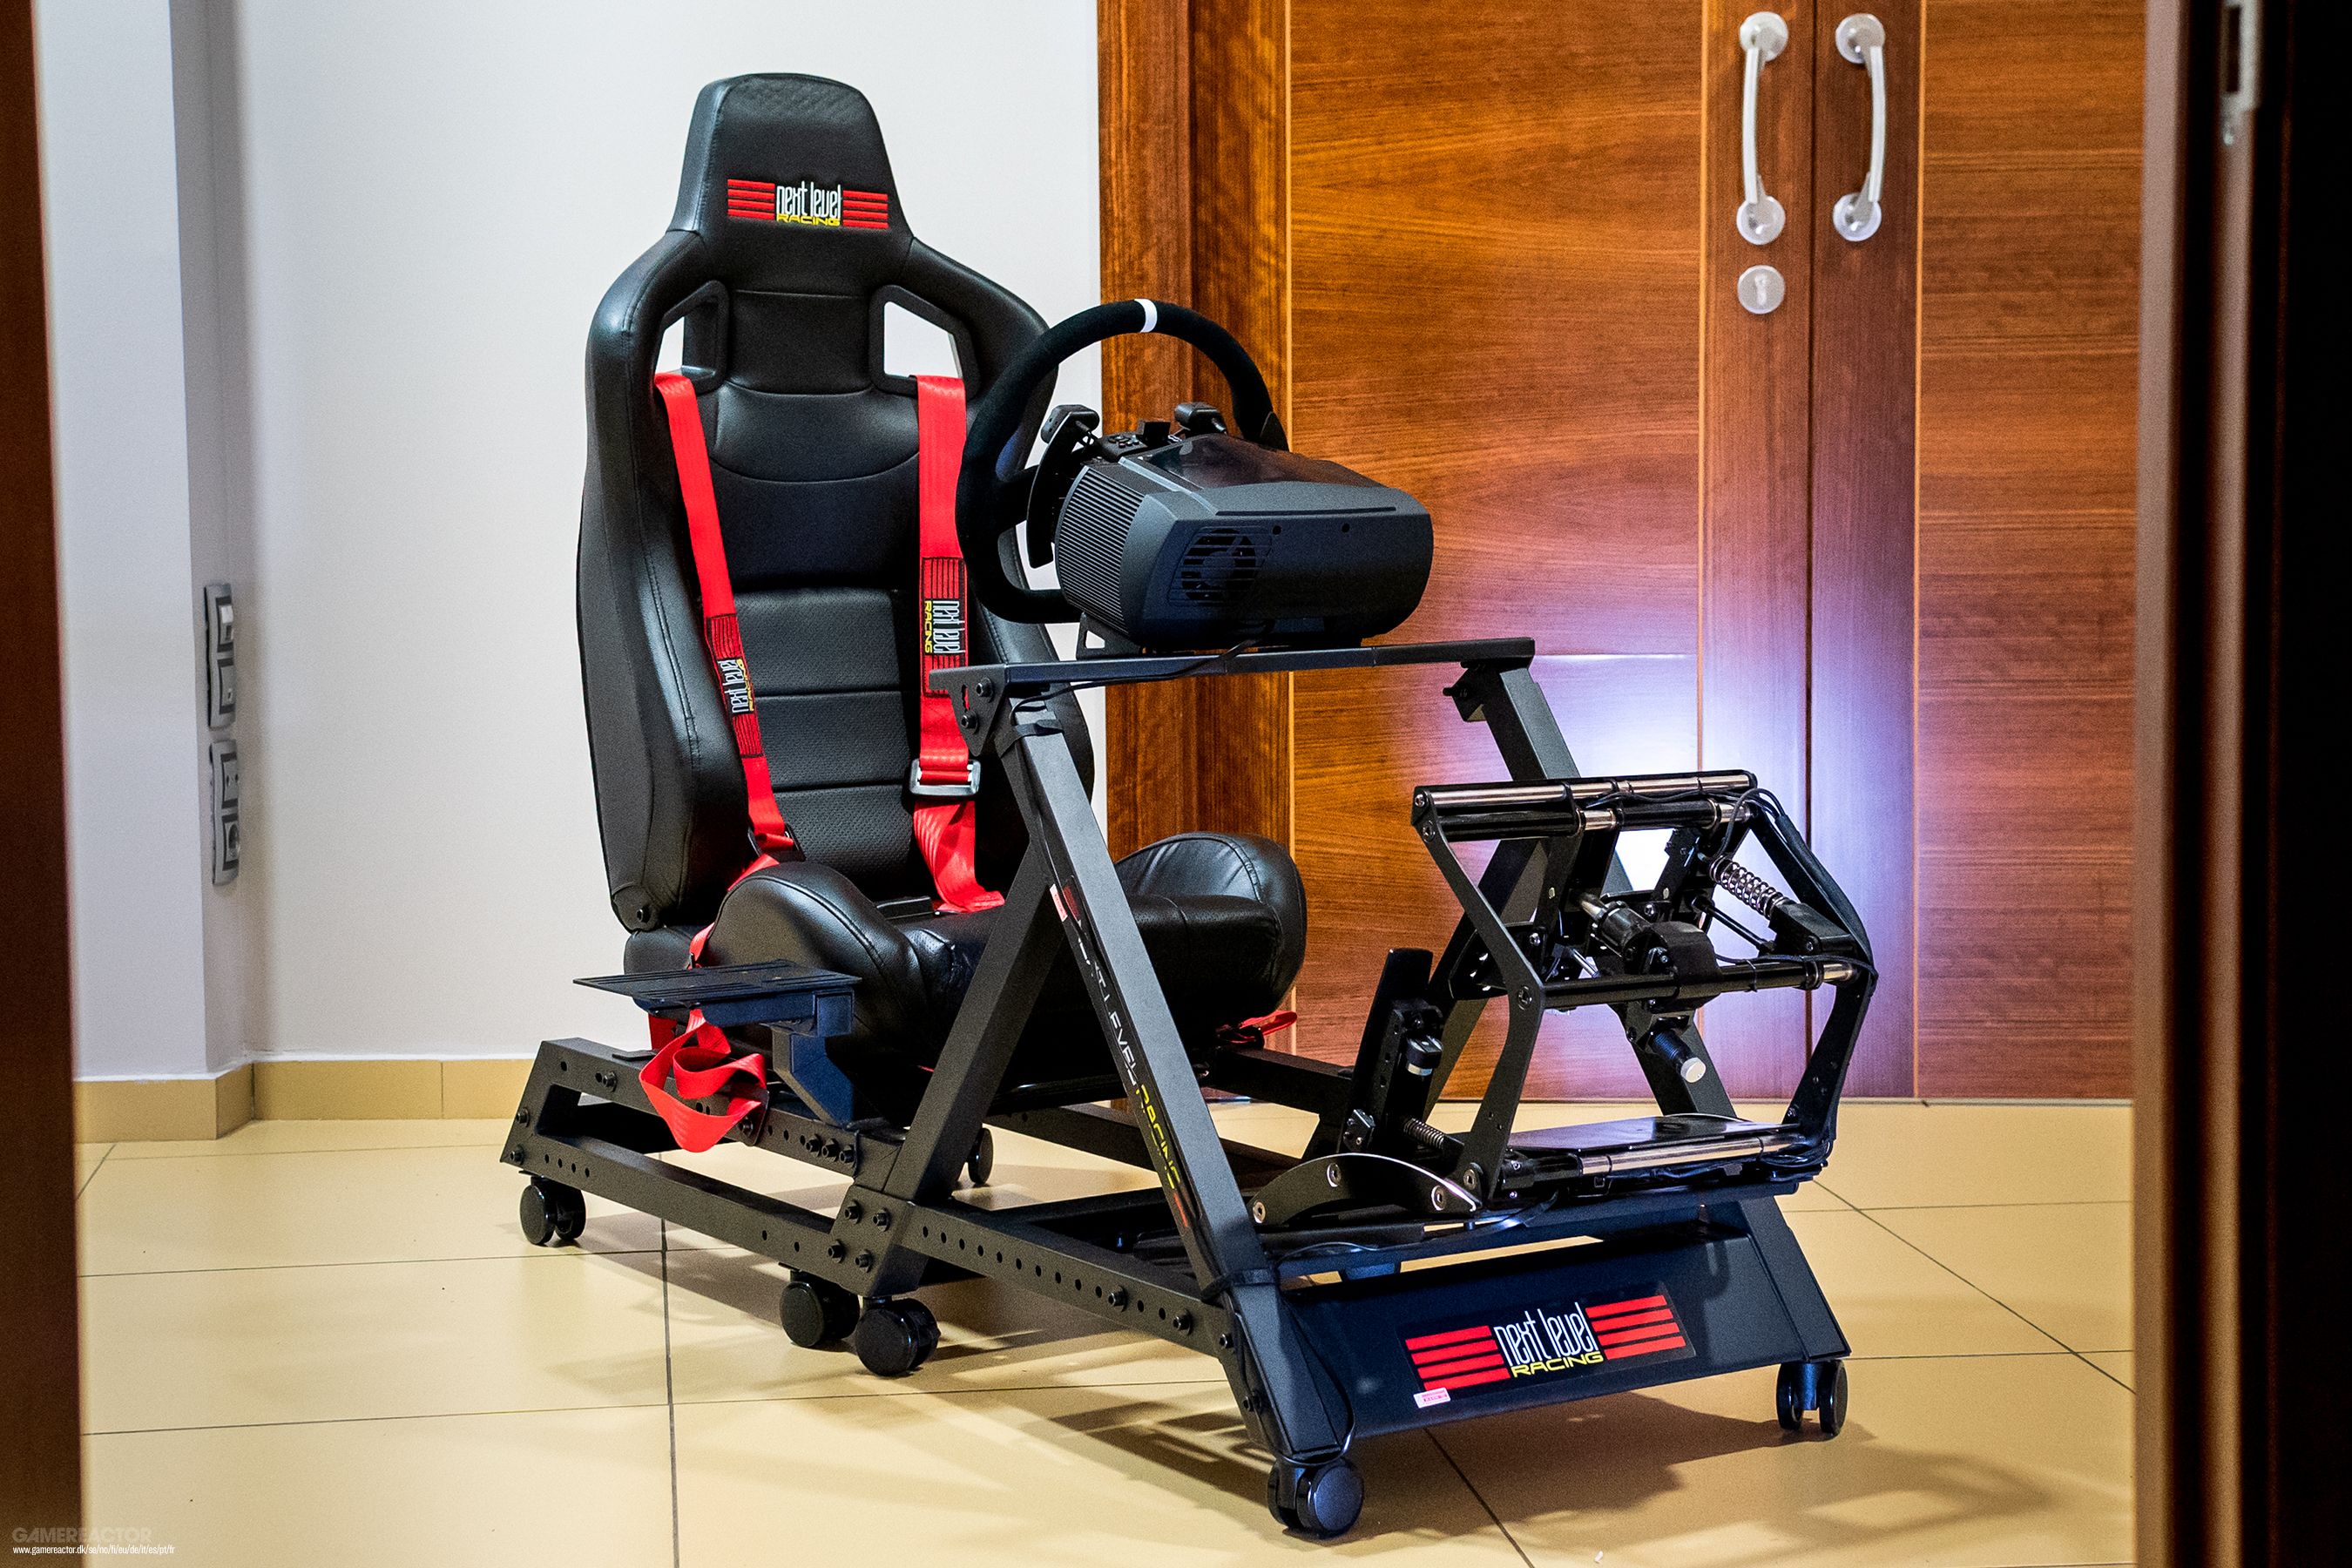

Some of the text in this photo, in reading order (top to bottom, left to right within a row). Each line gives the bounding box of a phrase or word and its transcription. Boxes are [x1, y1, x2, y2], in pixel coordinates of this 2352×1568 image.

[776, 180, 841, 220] next level
[776, 213, 841, 226] RACING
[933, 600, 966, 653] next level
[717, 659, 749, 713] next level
[1493, 1301, 1599, 1367] next level
[1511, 1351, 1604, 1377] RACING
